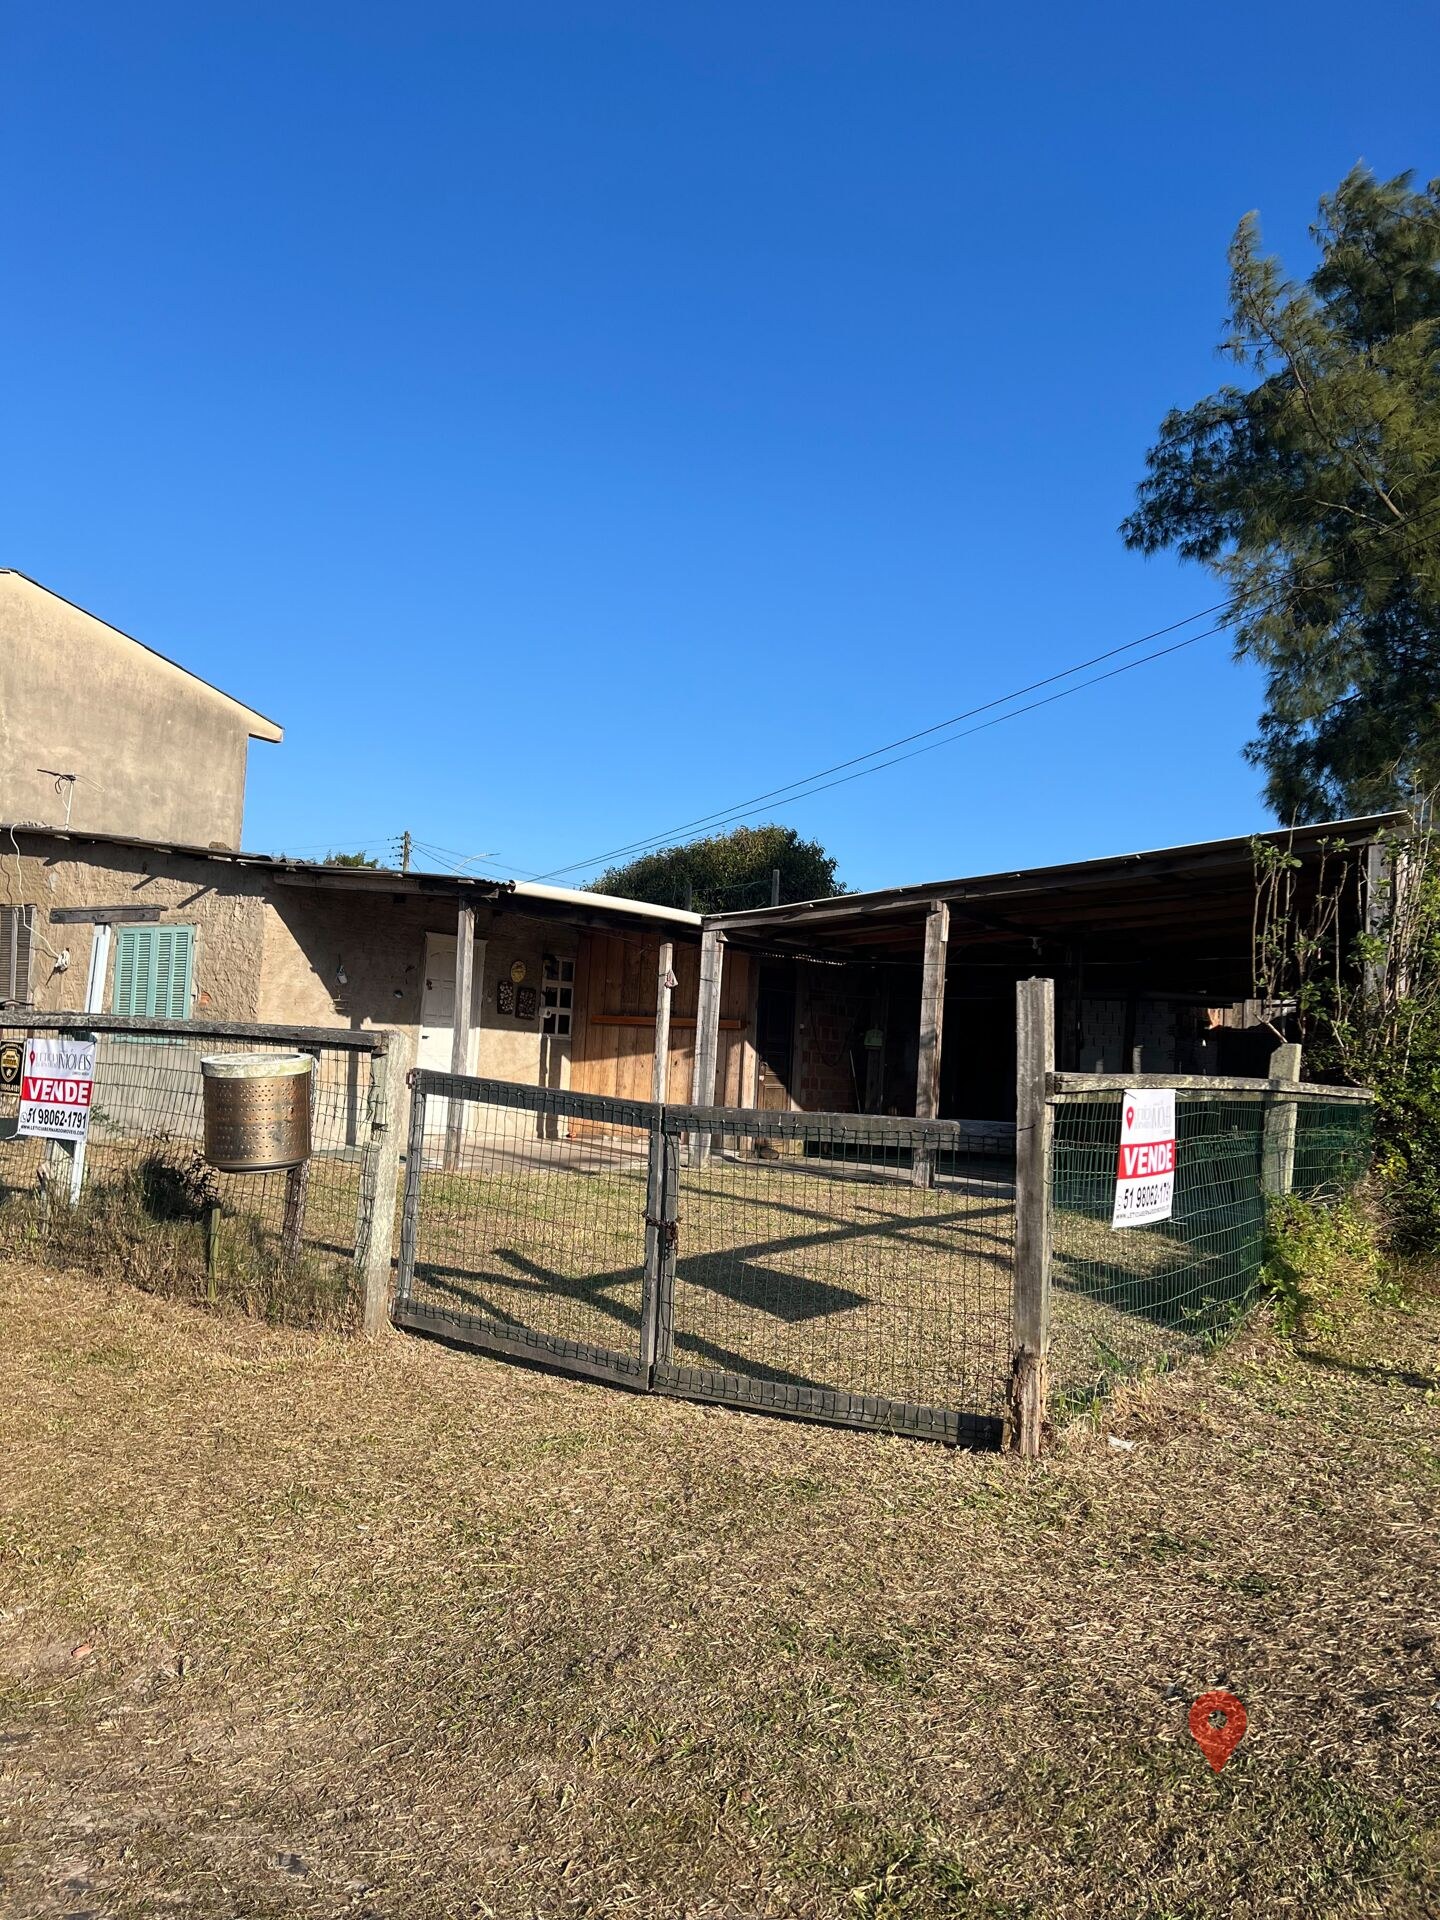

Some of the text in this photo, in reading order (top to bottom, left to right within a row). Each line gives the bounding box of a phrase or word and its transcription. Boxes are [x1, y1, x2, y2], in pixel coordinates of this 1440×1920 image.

[28, 1078, 90, 1104] VENDE
[26, 1107, 87, 1129] 51 98062-1791
[1123, 1142, 1172, 1176] VENDE
[1123, 1187, 1134, 1209] 51
